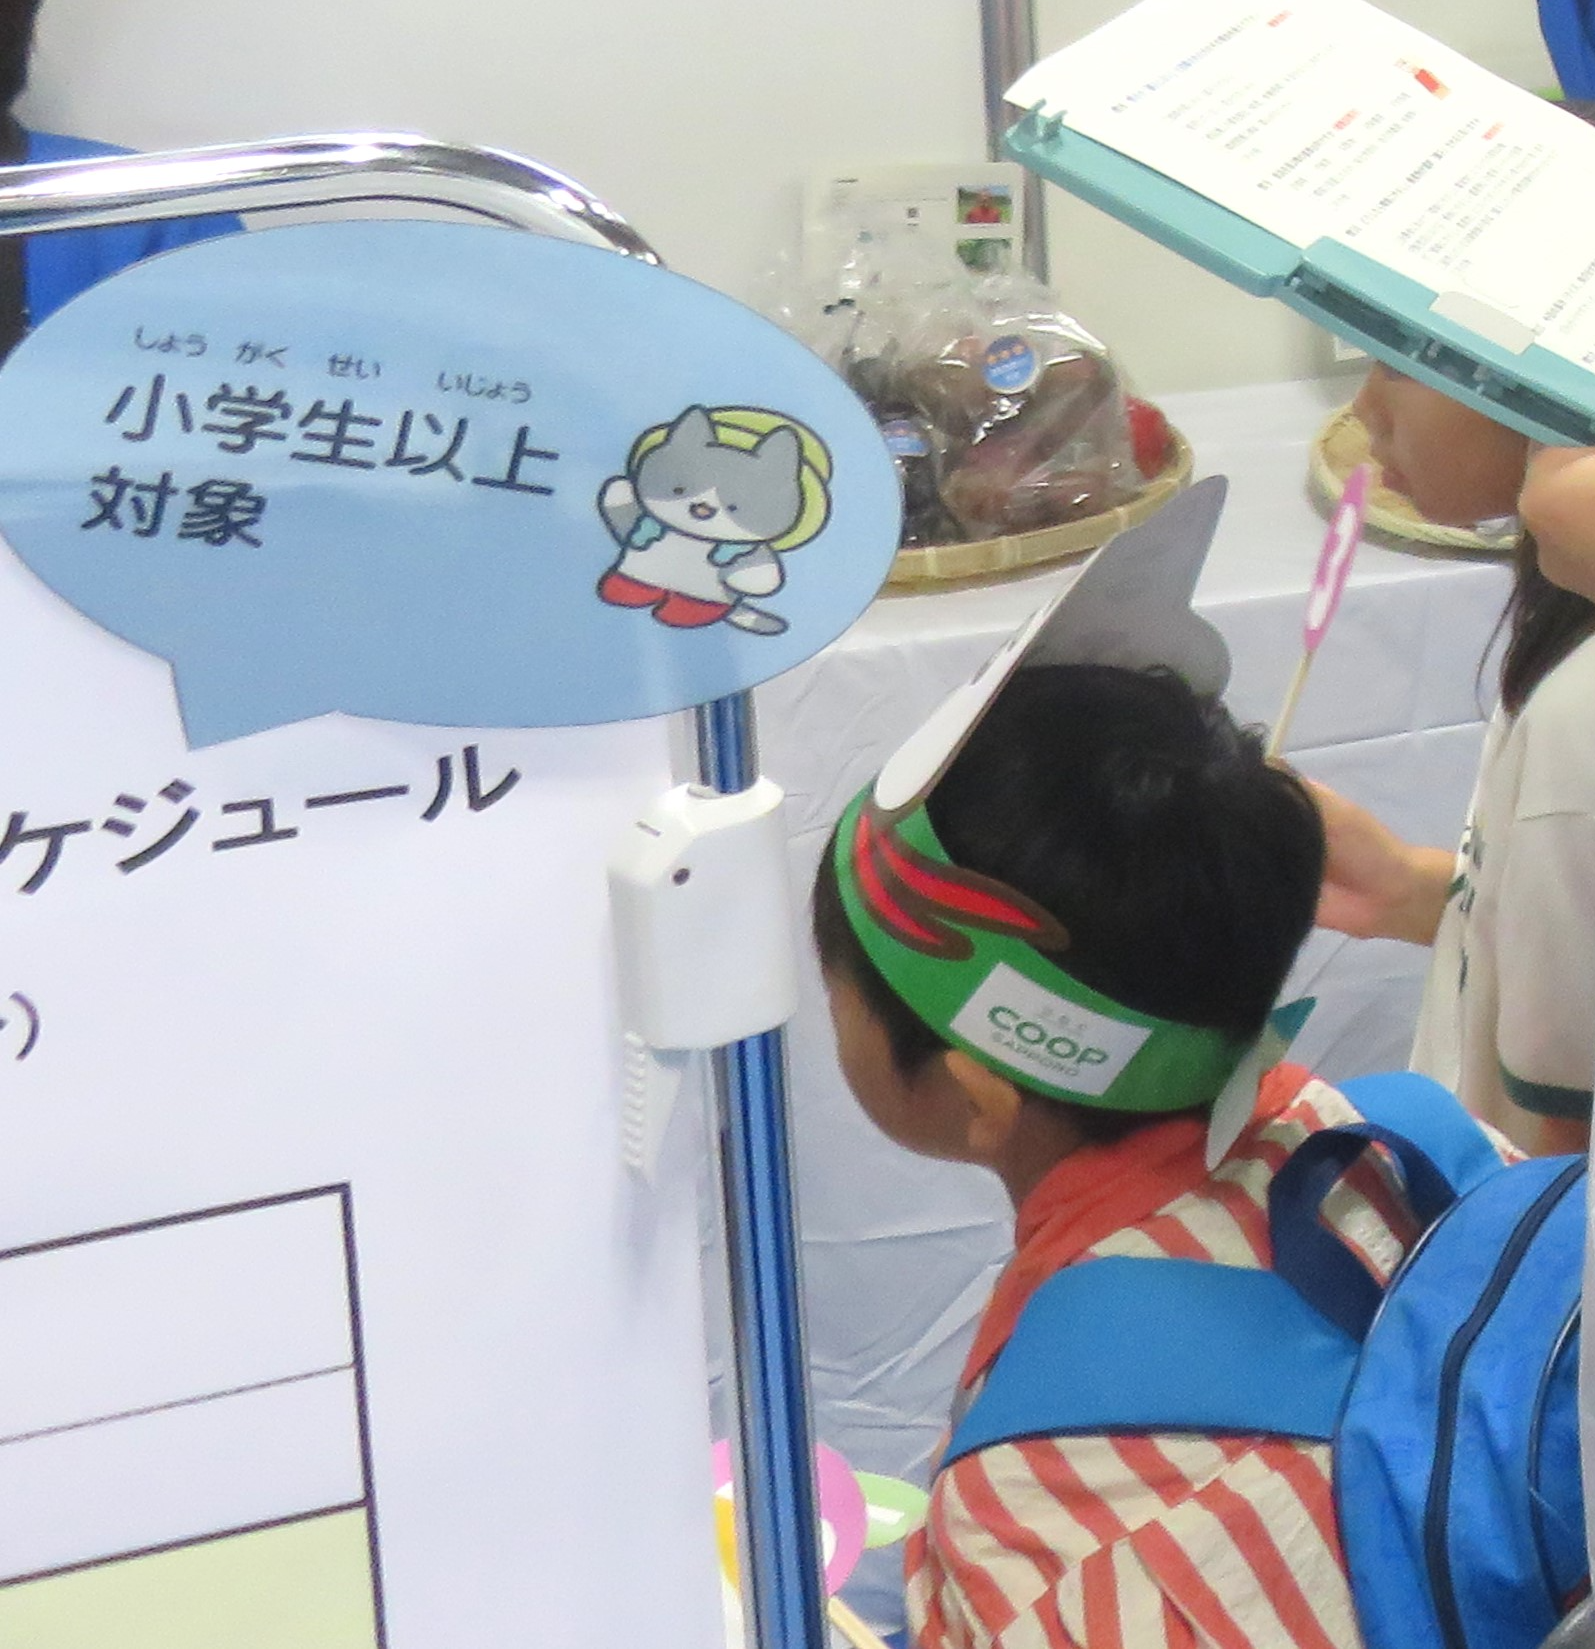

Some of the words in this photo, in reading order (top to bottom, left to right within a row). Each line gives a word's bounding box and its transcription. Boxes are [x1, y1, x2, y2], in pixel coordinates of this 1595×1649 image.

[134, 326, 207, 359] しょう
[235, 339, 287, 371] がく
[327, 354, 382, 380] せい
[437, 371, 533, 405] いじょう
[104, 372, 559, 497] 小学生以上
[81, 466, 267, 549] 対象
[0, 744, 522, 896] ケジュール
[987, 1005, 1110, 1065] COOP
